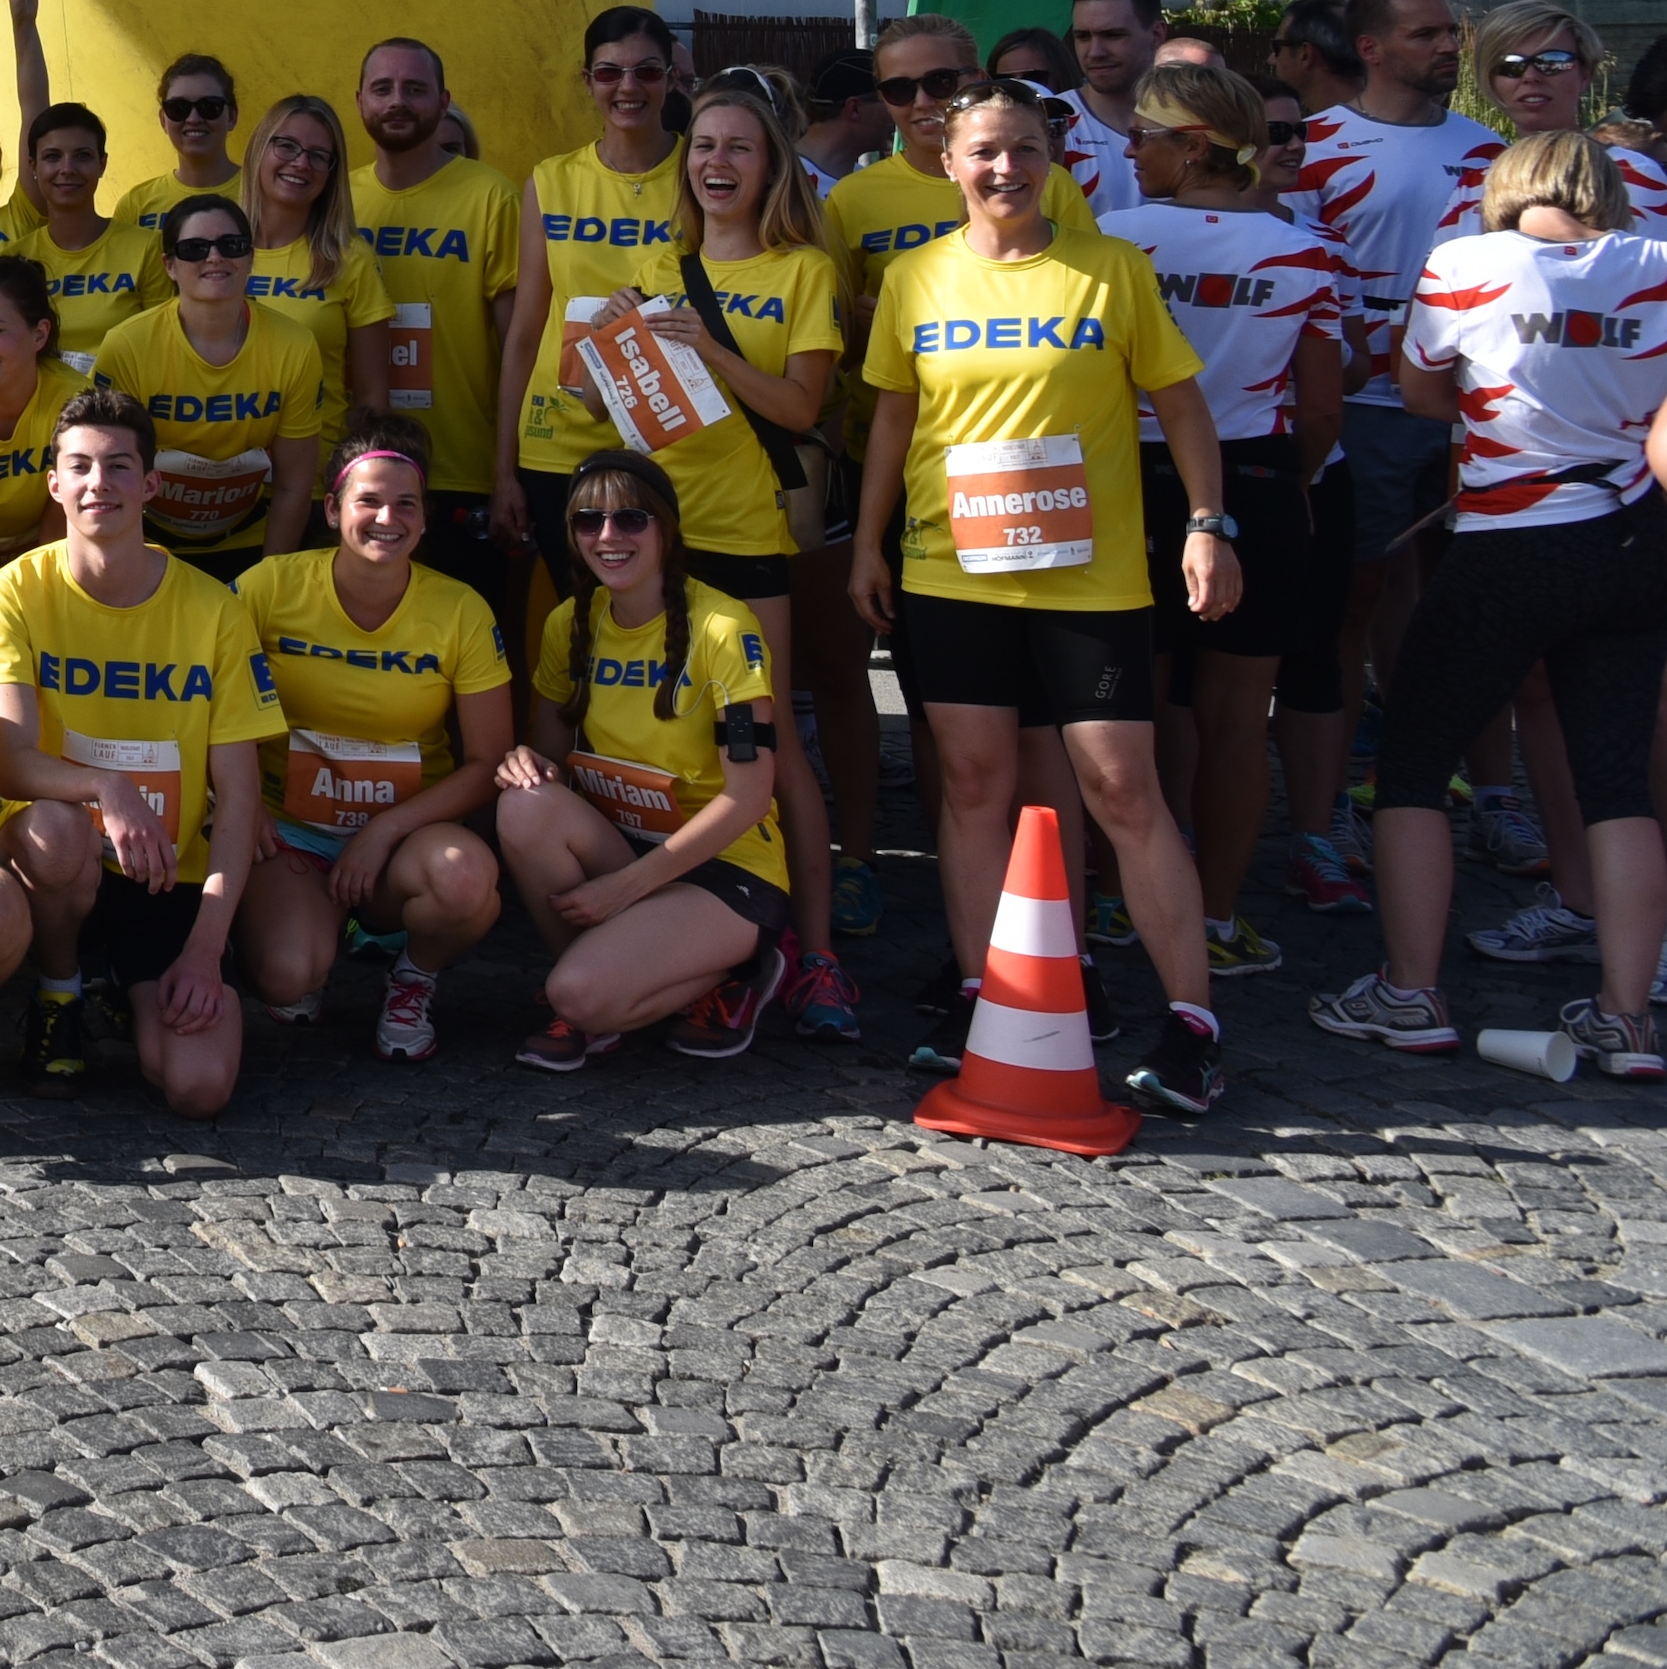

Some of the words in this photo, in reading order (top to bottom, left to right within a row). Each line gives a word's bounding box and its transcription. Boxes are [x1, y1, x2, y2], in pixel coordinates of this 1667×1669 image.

[912, 317, 1105, 354] EDEKA
[614, 327, 687, 432] Isabell
[616, 375, 638, 409] 726
[148, 390, 281, 423] EDEKA
[156, 479, 256, 505] Marion
[952, 487, 1086, 519] Annerose
[190, 509, 219, 521] 770
[1003, 526, 1043, 545] 732
[278, 636, 440, 675] EDEKA
[39, 651, 213, 702] EDEKA
[1095, 665, 1117, 698] GORE
[94, 750, 115, 759] LAUF
[310, 766, 396, 805] Anna
[573, 765, 673, 812] Miriam
[335, 810, 368, 827] 738
[615, 809, 643, 829] 797
